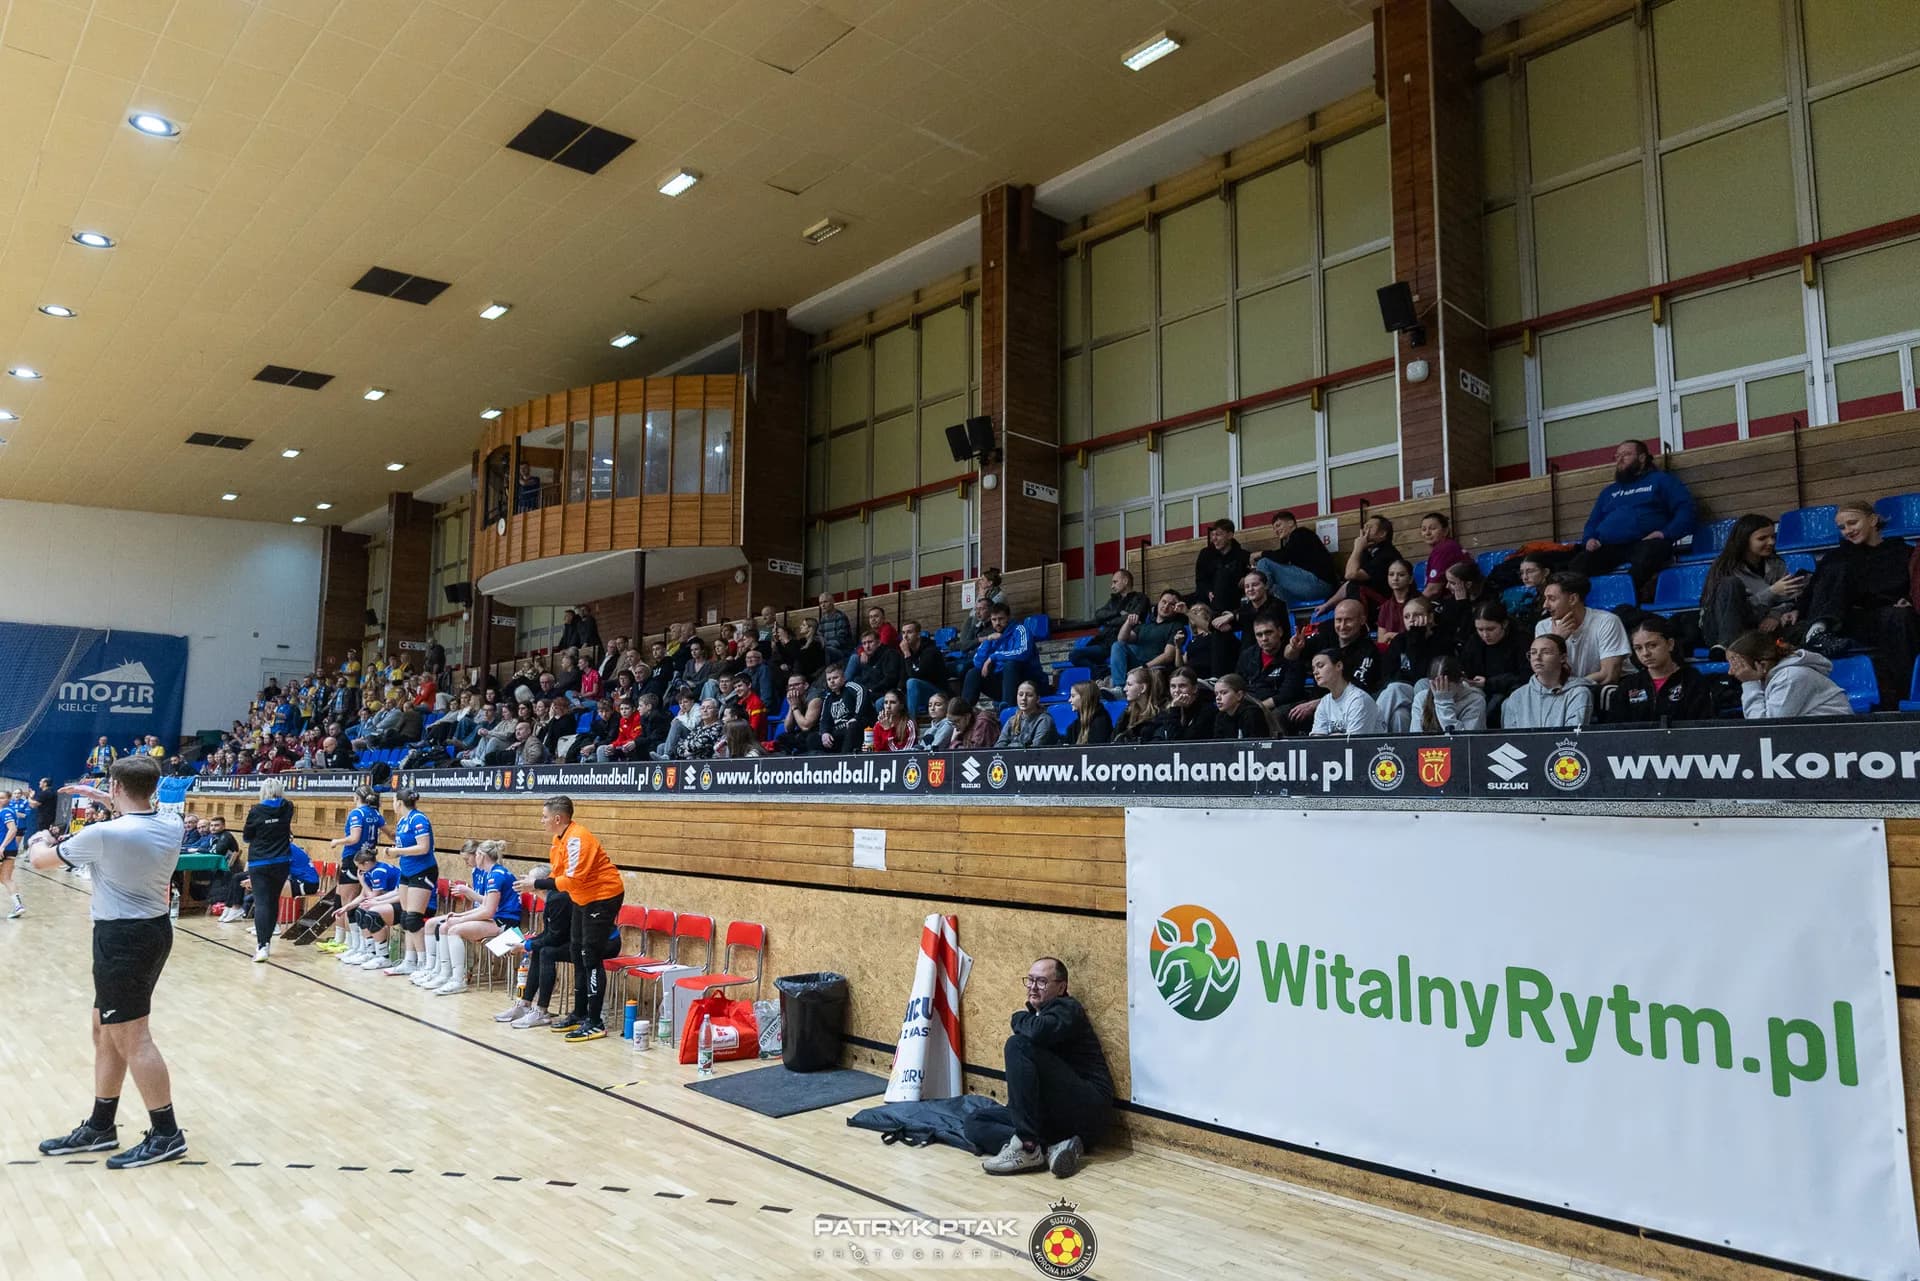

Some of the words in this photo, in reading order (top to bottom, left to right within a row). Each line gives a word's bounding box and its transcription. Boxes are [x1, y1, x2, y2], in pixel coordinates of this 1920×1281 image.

[58, 703, 98, 713] KIELCE
[415, 771, 494, 791] www.koronahandball.pl
[537, 766, 649, 791] www.koronahandball.pl
[716, 760, 897, 791] www.koronahandball.pl
[1015, 748, 1353, 792] www.koronahandball.pl
[1422, 763, 1444, 783] CK
[1487, 782, 1529, 790] SUZUKI
[1256, 940, 1859, 1097] WitalnyRytm.pl
